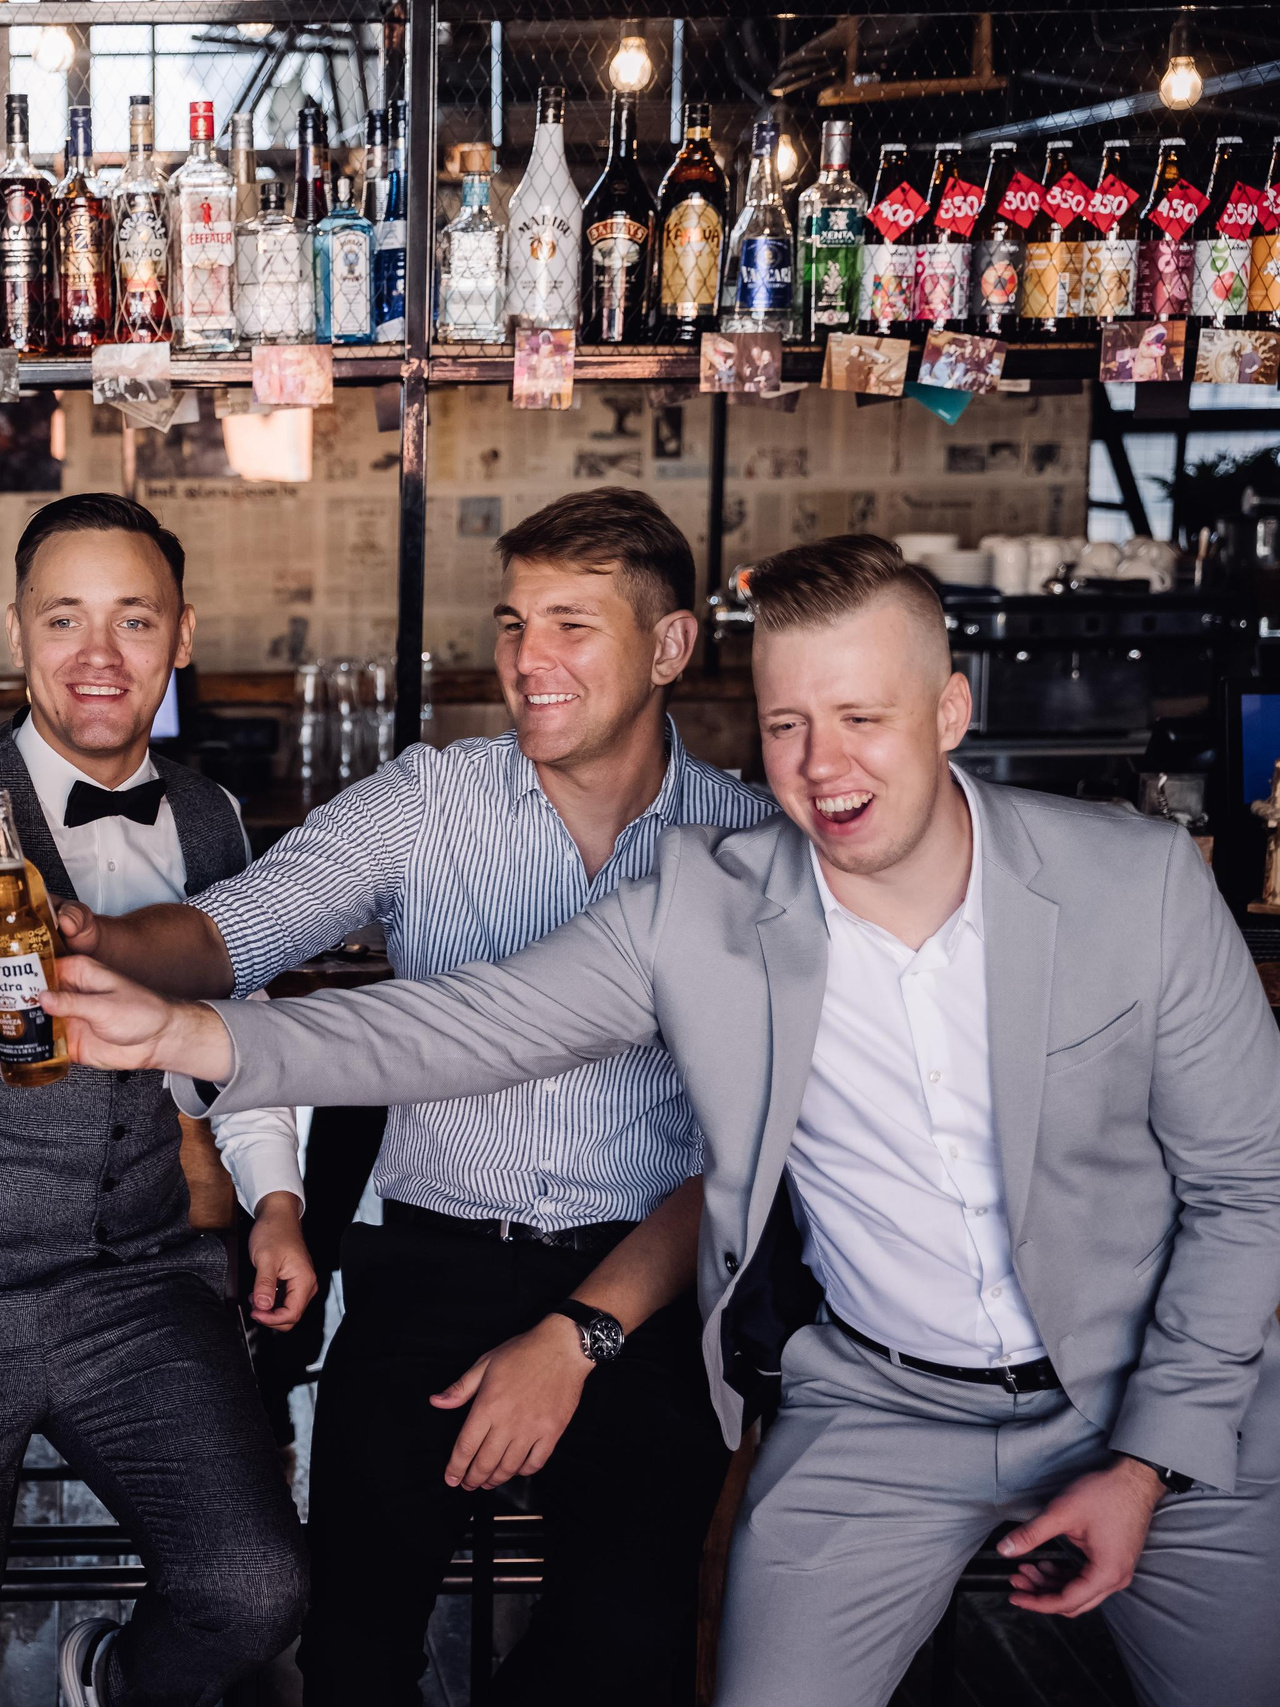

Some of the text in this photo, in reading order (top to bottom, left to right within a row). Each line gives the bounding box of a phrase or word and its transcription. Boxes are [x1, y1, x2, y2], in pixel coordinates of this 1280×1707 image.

[940, 196, 979, 219] 350
[1004, 191, 1040, 211] 300
[1047, 186, 1085, 212] 350
[1088, 192, 1128, 215] 350
[1157, 198, 1198, 223] 450
[1223, 203, 1258, 225] 350
[665, 223, 719, 248] KAÚA
[820, 230, 855, 240] XENTA
[742, 266, 791, 283] VACARI
